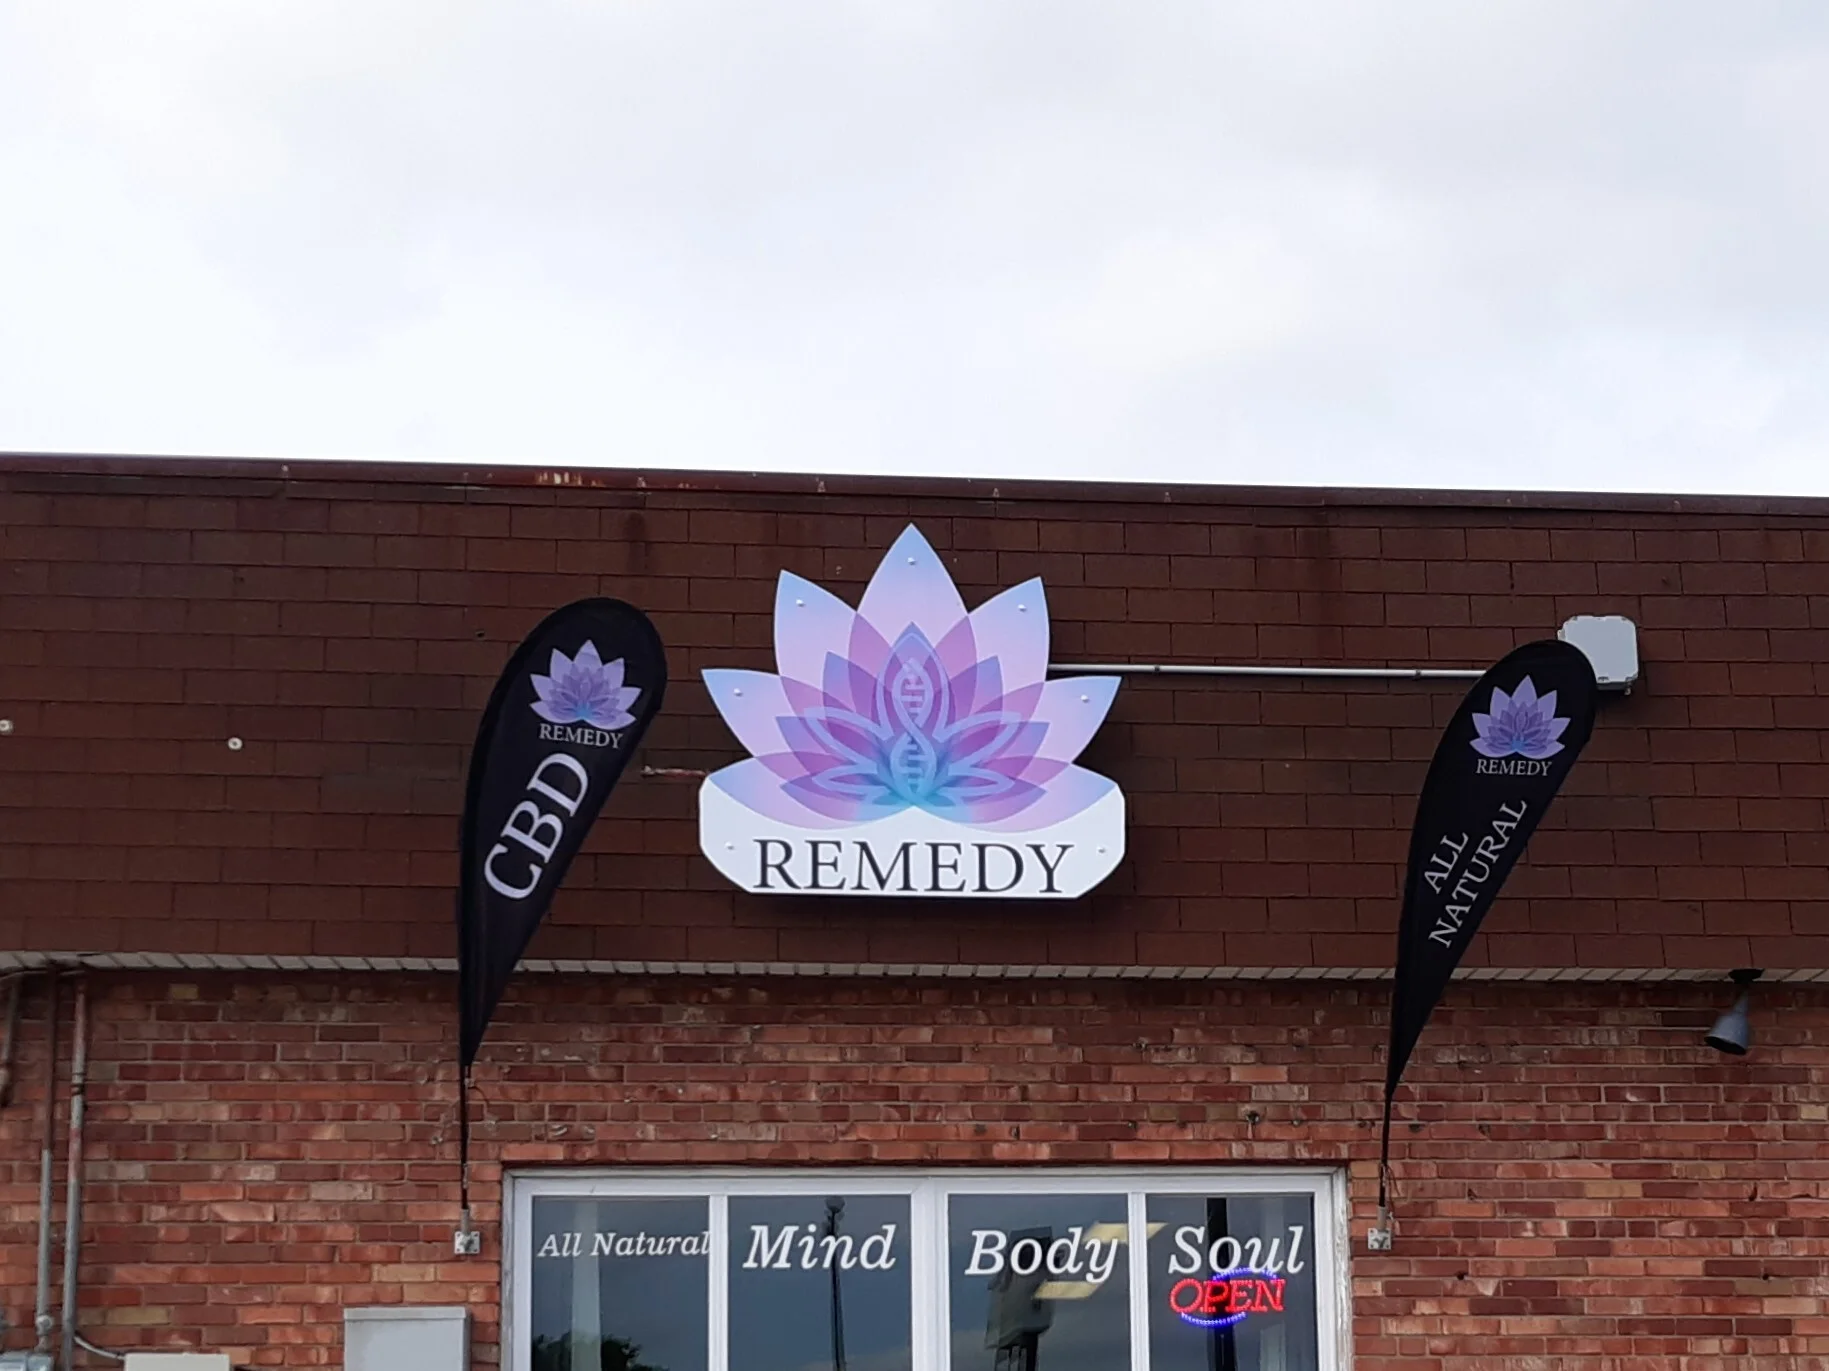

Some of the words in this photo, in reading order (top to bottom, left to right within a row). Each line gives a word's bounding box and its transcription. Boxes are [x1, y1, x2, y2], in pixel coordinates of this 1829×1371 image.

[538, 722, 624, 749] REMEDY
[1475, 758, 1553, 777] REMEDY
[484, 753, 589, 899] CBD
[752, 838, 1075, 894] REMEDY
[1424, 831, 1469, 894] ALL
[1428, 800, 1527, 948] NATURAL
[537, 1232, 582, 1257] All
[591, 1230, 711, 1257] Natural
[742, 1223, 897, 1270] Mind
[964, 1226, 1118, 1283] Body
[1168, 1225, 1304, 1274] Soul
[1169, 1277, 1286, 1314] OPEN
